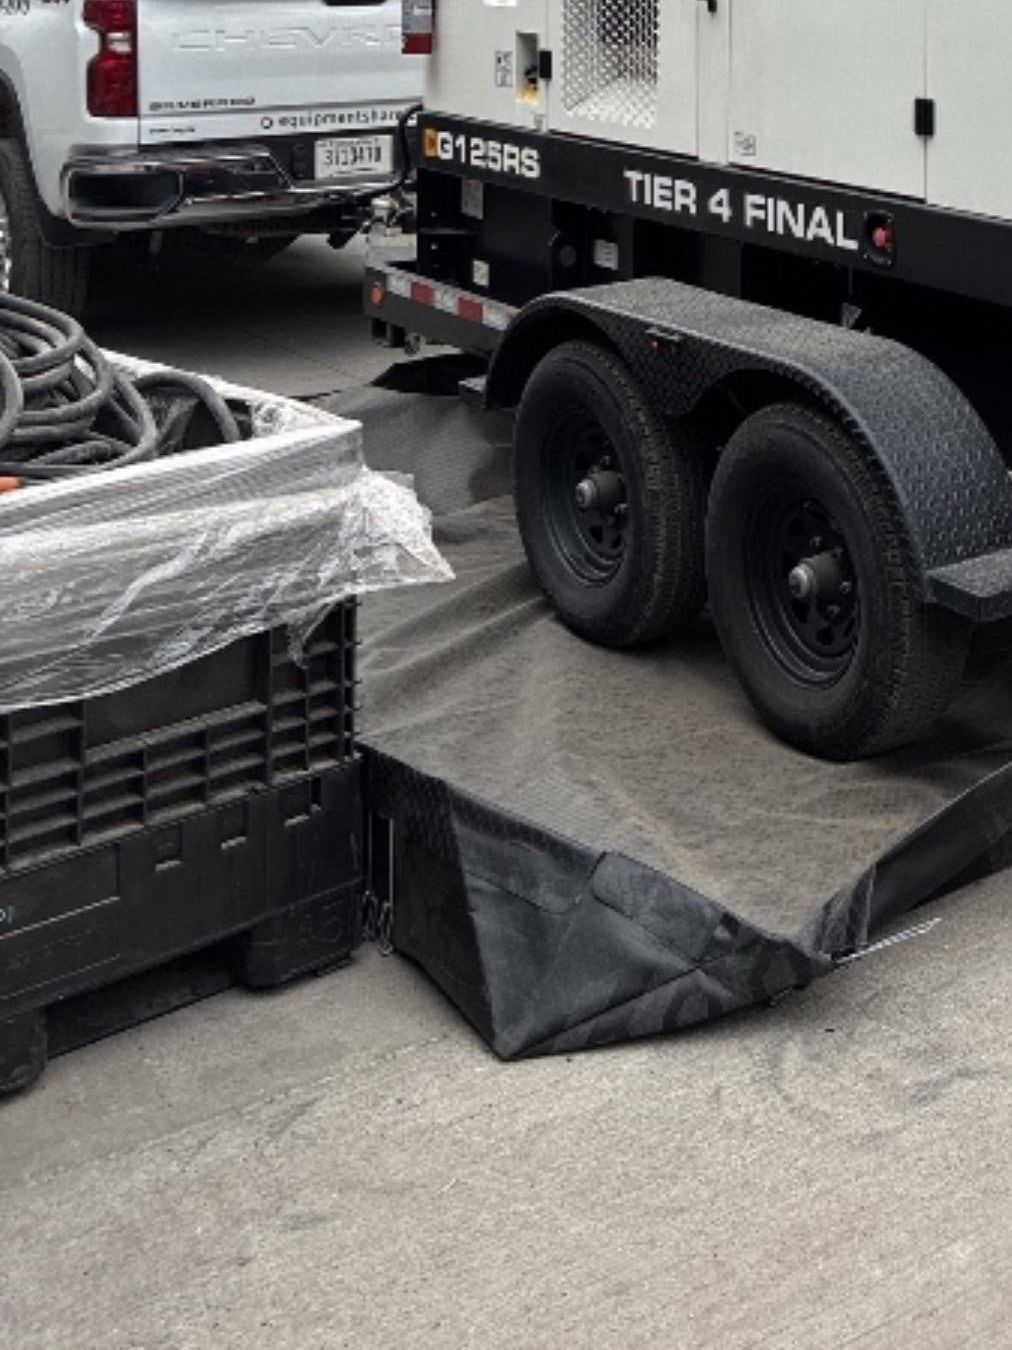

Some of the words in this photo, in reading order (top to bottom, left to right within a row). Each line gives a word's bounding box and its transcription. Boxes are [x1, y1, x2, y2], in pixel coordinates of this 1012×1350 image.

[436, 131, 541, 179] G125RS
[623, 169, 697, 215] TIER
[708, 188, 732, 224] 4
[743, 193, 859, 251] FINAL
